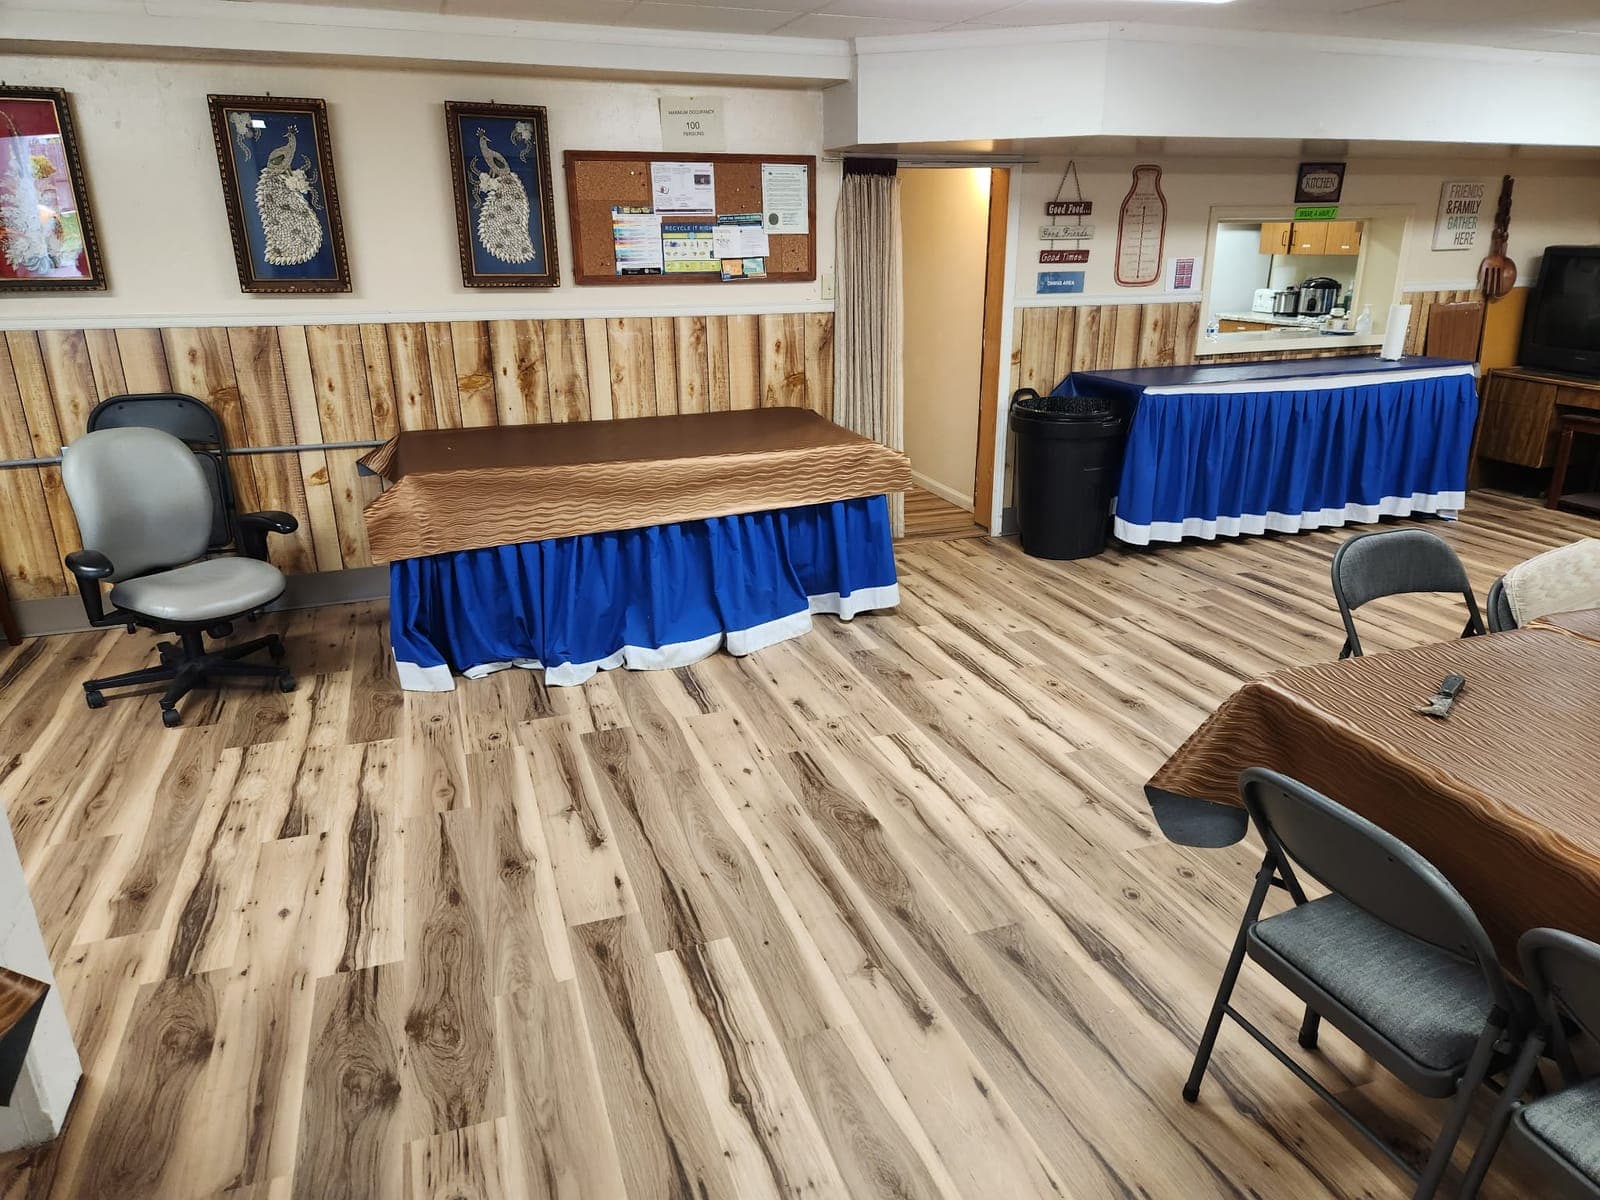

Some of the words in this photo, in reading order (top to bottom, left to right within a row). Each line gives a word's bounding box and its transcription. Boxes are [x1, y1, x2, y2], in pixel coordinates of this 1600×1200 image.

[686, 121, 701, 130] 100
[1305, 176, 1337, 189] KITCHEN
[1450, 183, 1485, 198] FRIENDS
[1048, 204, 1066, 214] Good
[1447, 215, 1478, 230] GATHER
[1454, 231, 1476, 246] HERE
[1041, 253, 1059, 262] Good
